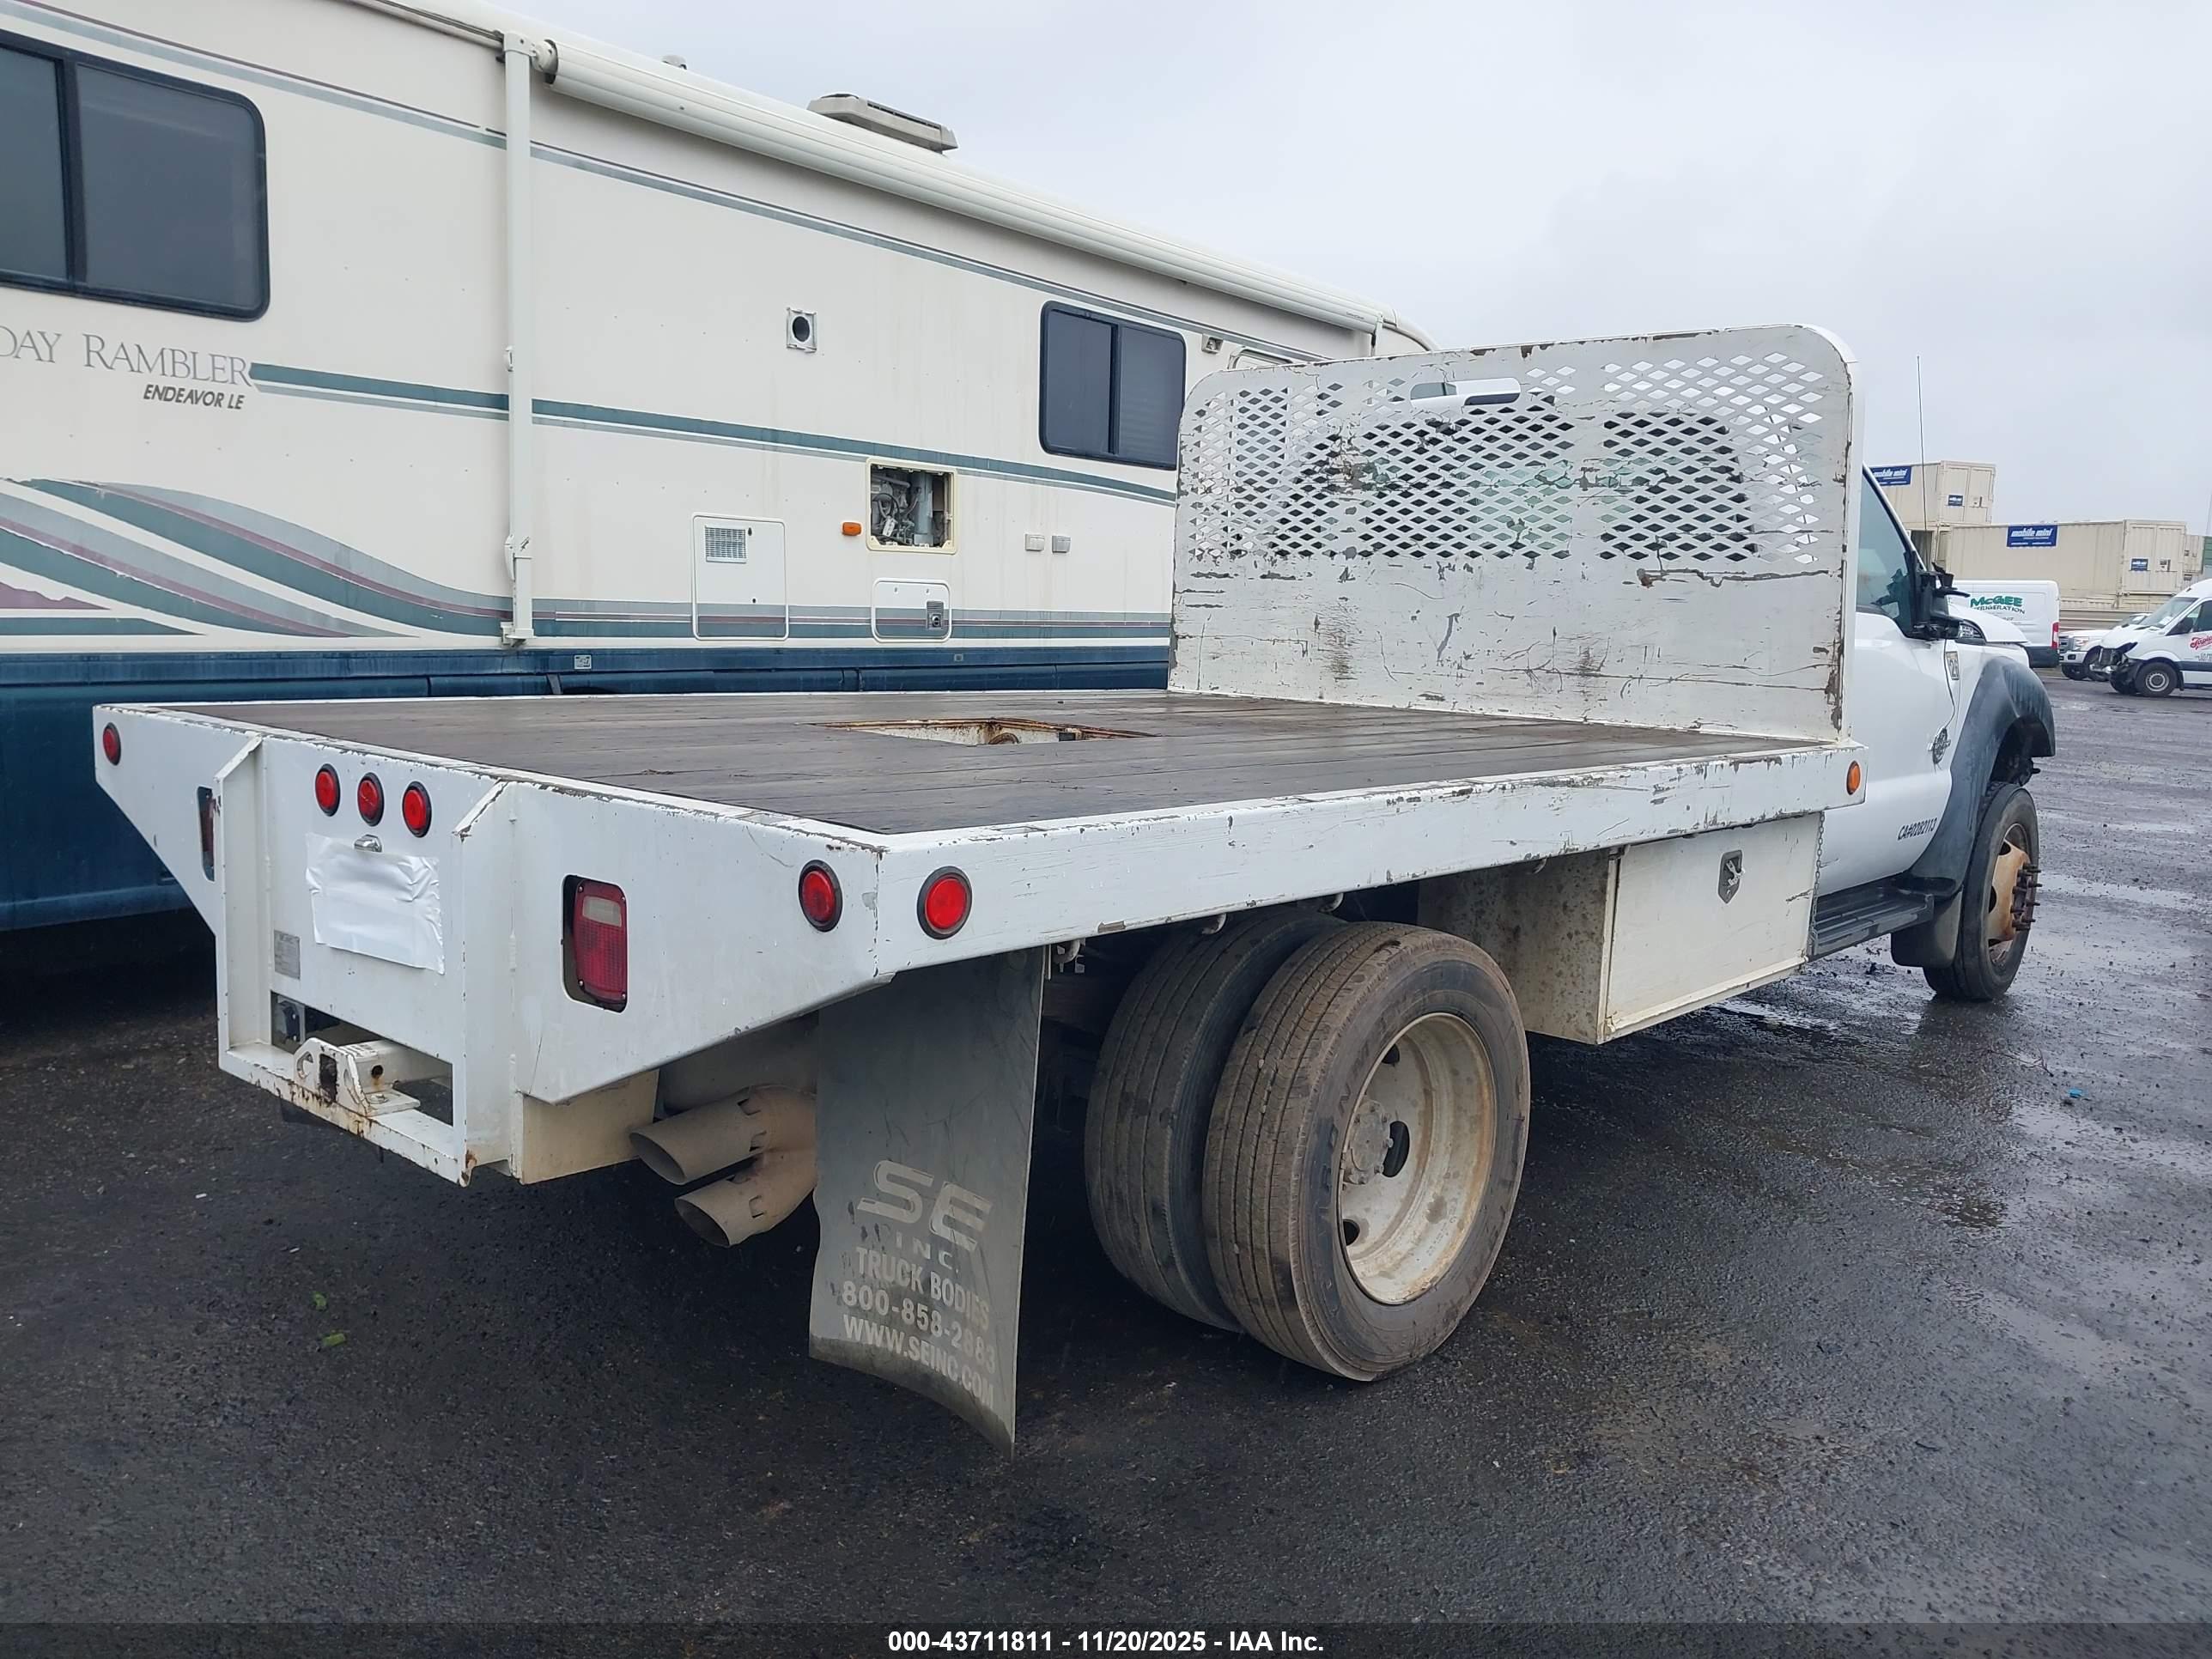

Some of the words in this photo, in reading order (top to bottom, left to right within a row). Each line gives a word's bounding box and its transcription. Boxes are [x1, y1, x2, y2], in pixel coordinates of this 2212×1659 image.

[82, 333, 252, 387] RAMBLER
[143, 384, 224, 408] ENDEAVOR
[228, 393, 245, 410] LE
[856, 1247, 924, 1294] TRUCK
[930, 1271, 989, 1330] BODIES
[843, 1314, 994, 1410] WWW.SEINC.COM
